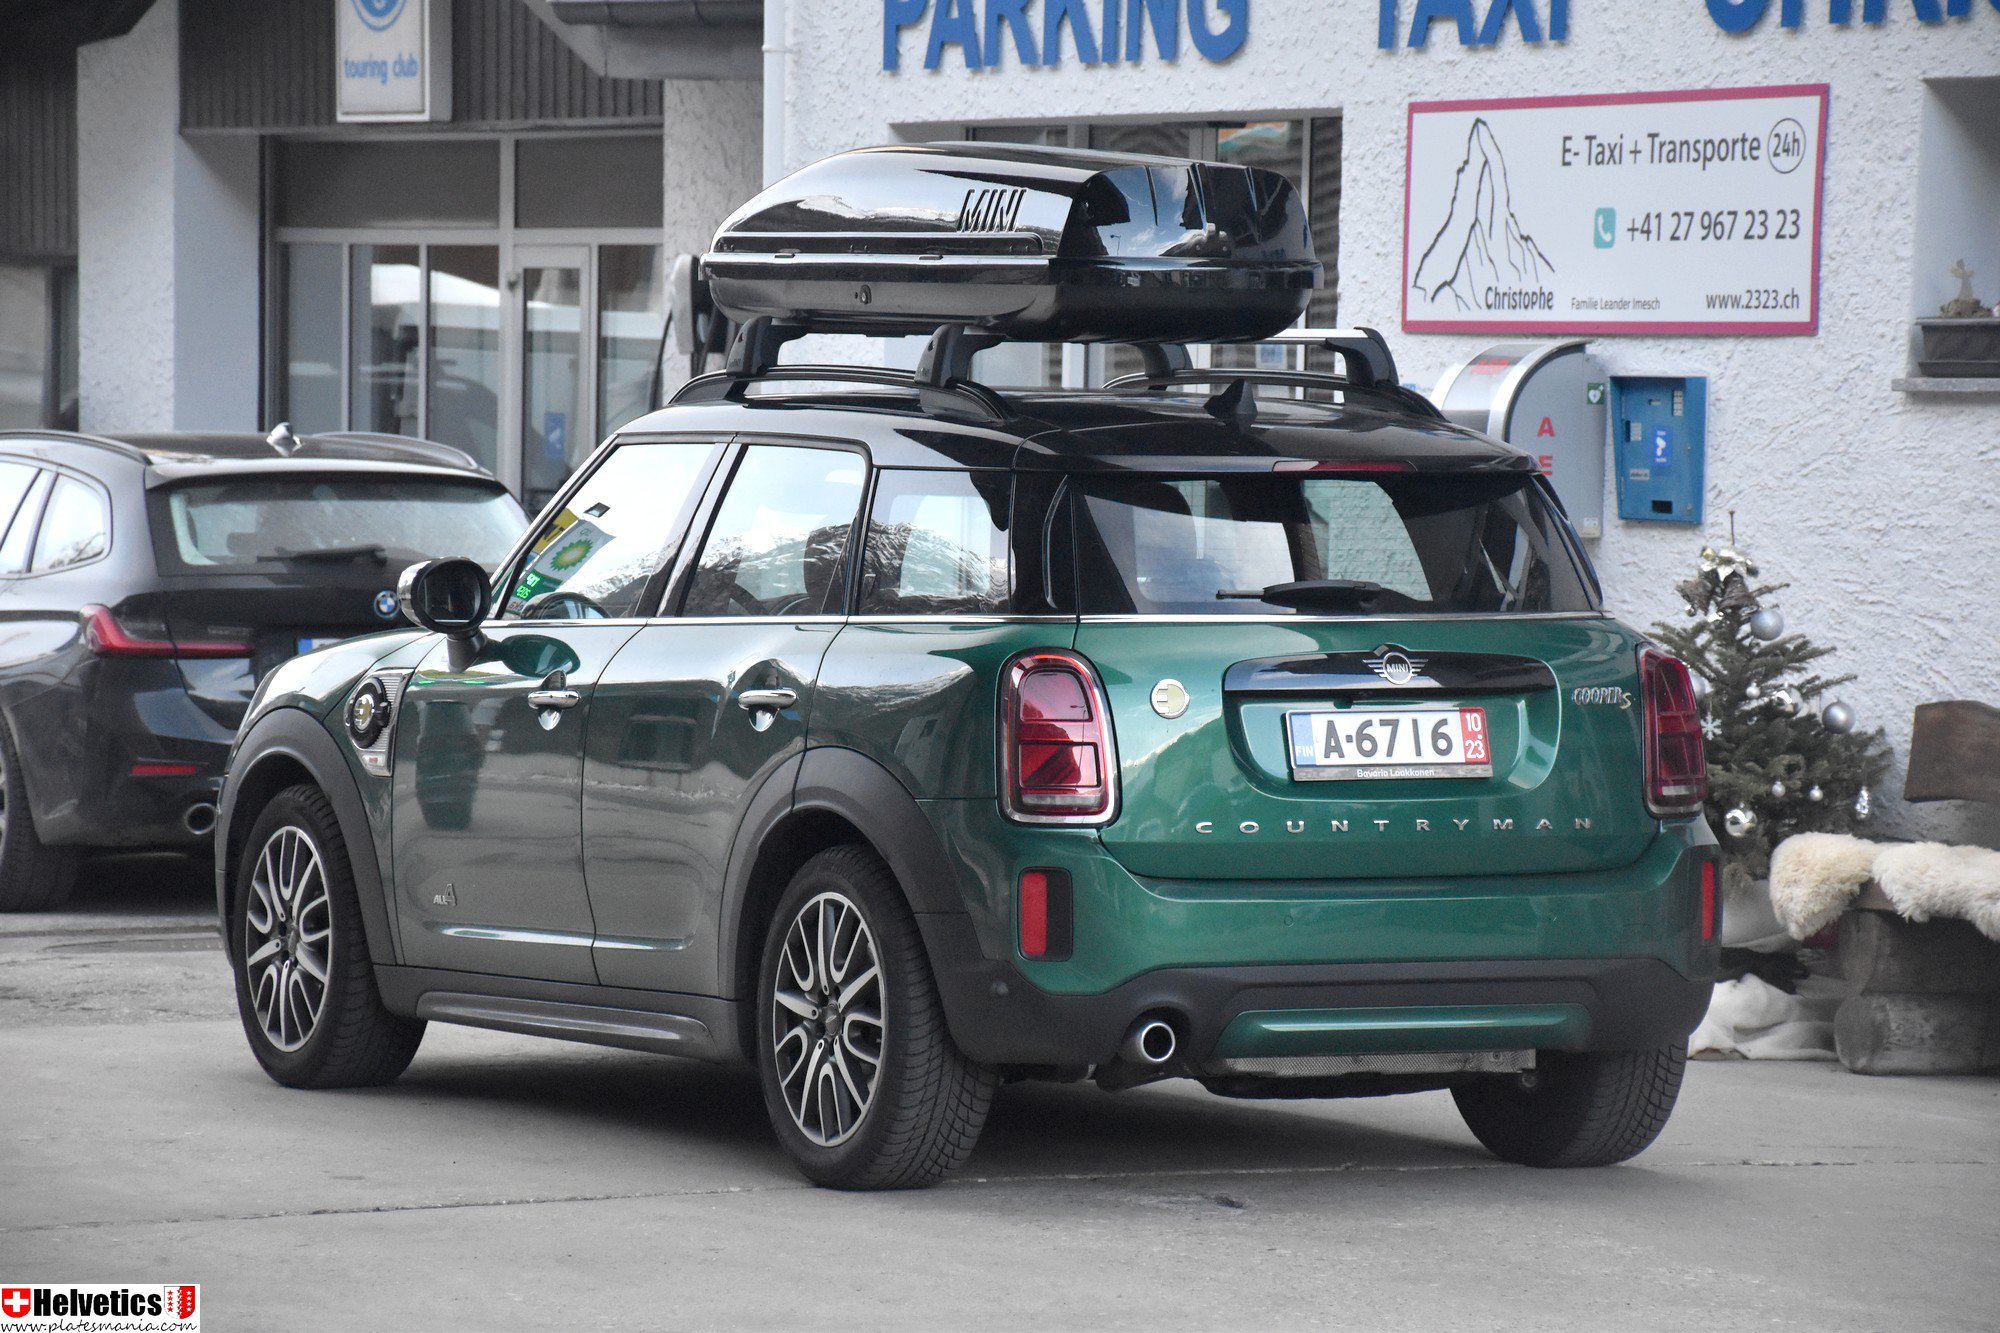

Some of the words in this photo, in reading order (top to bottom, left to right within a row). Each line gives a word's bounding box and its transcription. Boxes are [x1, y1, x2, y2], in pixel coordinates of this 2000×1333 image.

[344, 57, 387, 85] touring
[393, 53, 417, 77] club
[1647, 132, 1761, 171] Transporte
[1773, 131, 1800, 157] 24h
[957, 189, 1027, 232] MINI
[1627, 211, 1662, 241] +41
[1670, 211, 1694, 240] 27
[1700, 210, 1738, 240] 967
[1743, 210, 1768, 239] 23
[1775, 209, 1800, 239] 23
[1485, 286, 1554, 311] Christophe
[1571, 297, 1598, 310] Familie
[1600, 297, 1631, 310] Leander
[1706, 288, 1799, 310] www.2323.ch
[1386, 663, 1409, 673] MINI
[1573, 686, 1623, 705] COOPER
[1620, 691, 1632, 709] S
[1465, 712, 1482, 732] 10
[1295, 745, 1314, 757] FIN
[1323, 718, 1453, 759] A-6716
[1465, 739, 1485, 759] 23
[1356, 768, 1388, 778] Bavaria
[1390, 767, 1435, 777] Laakkonen
[1195, 818, 1592, 834] COUNTRYMAN
